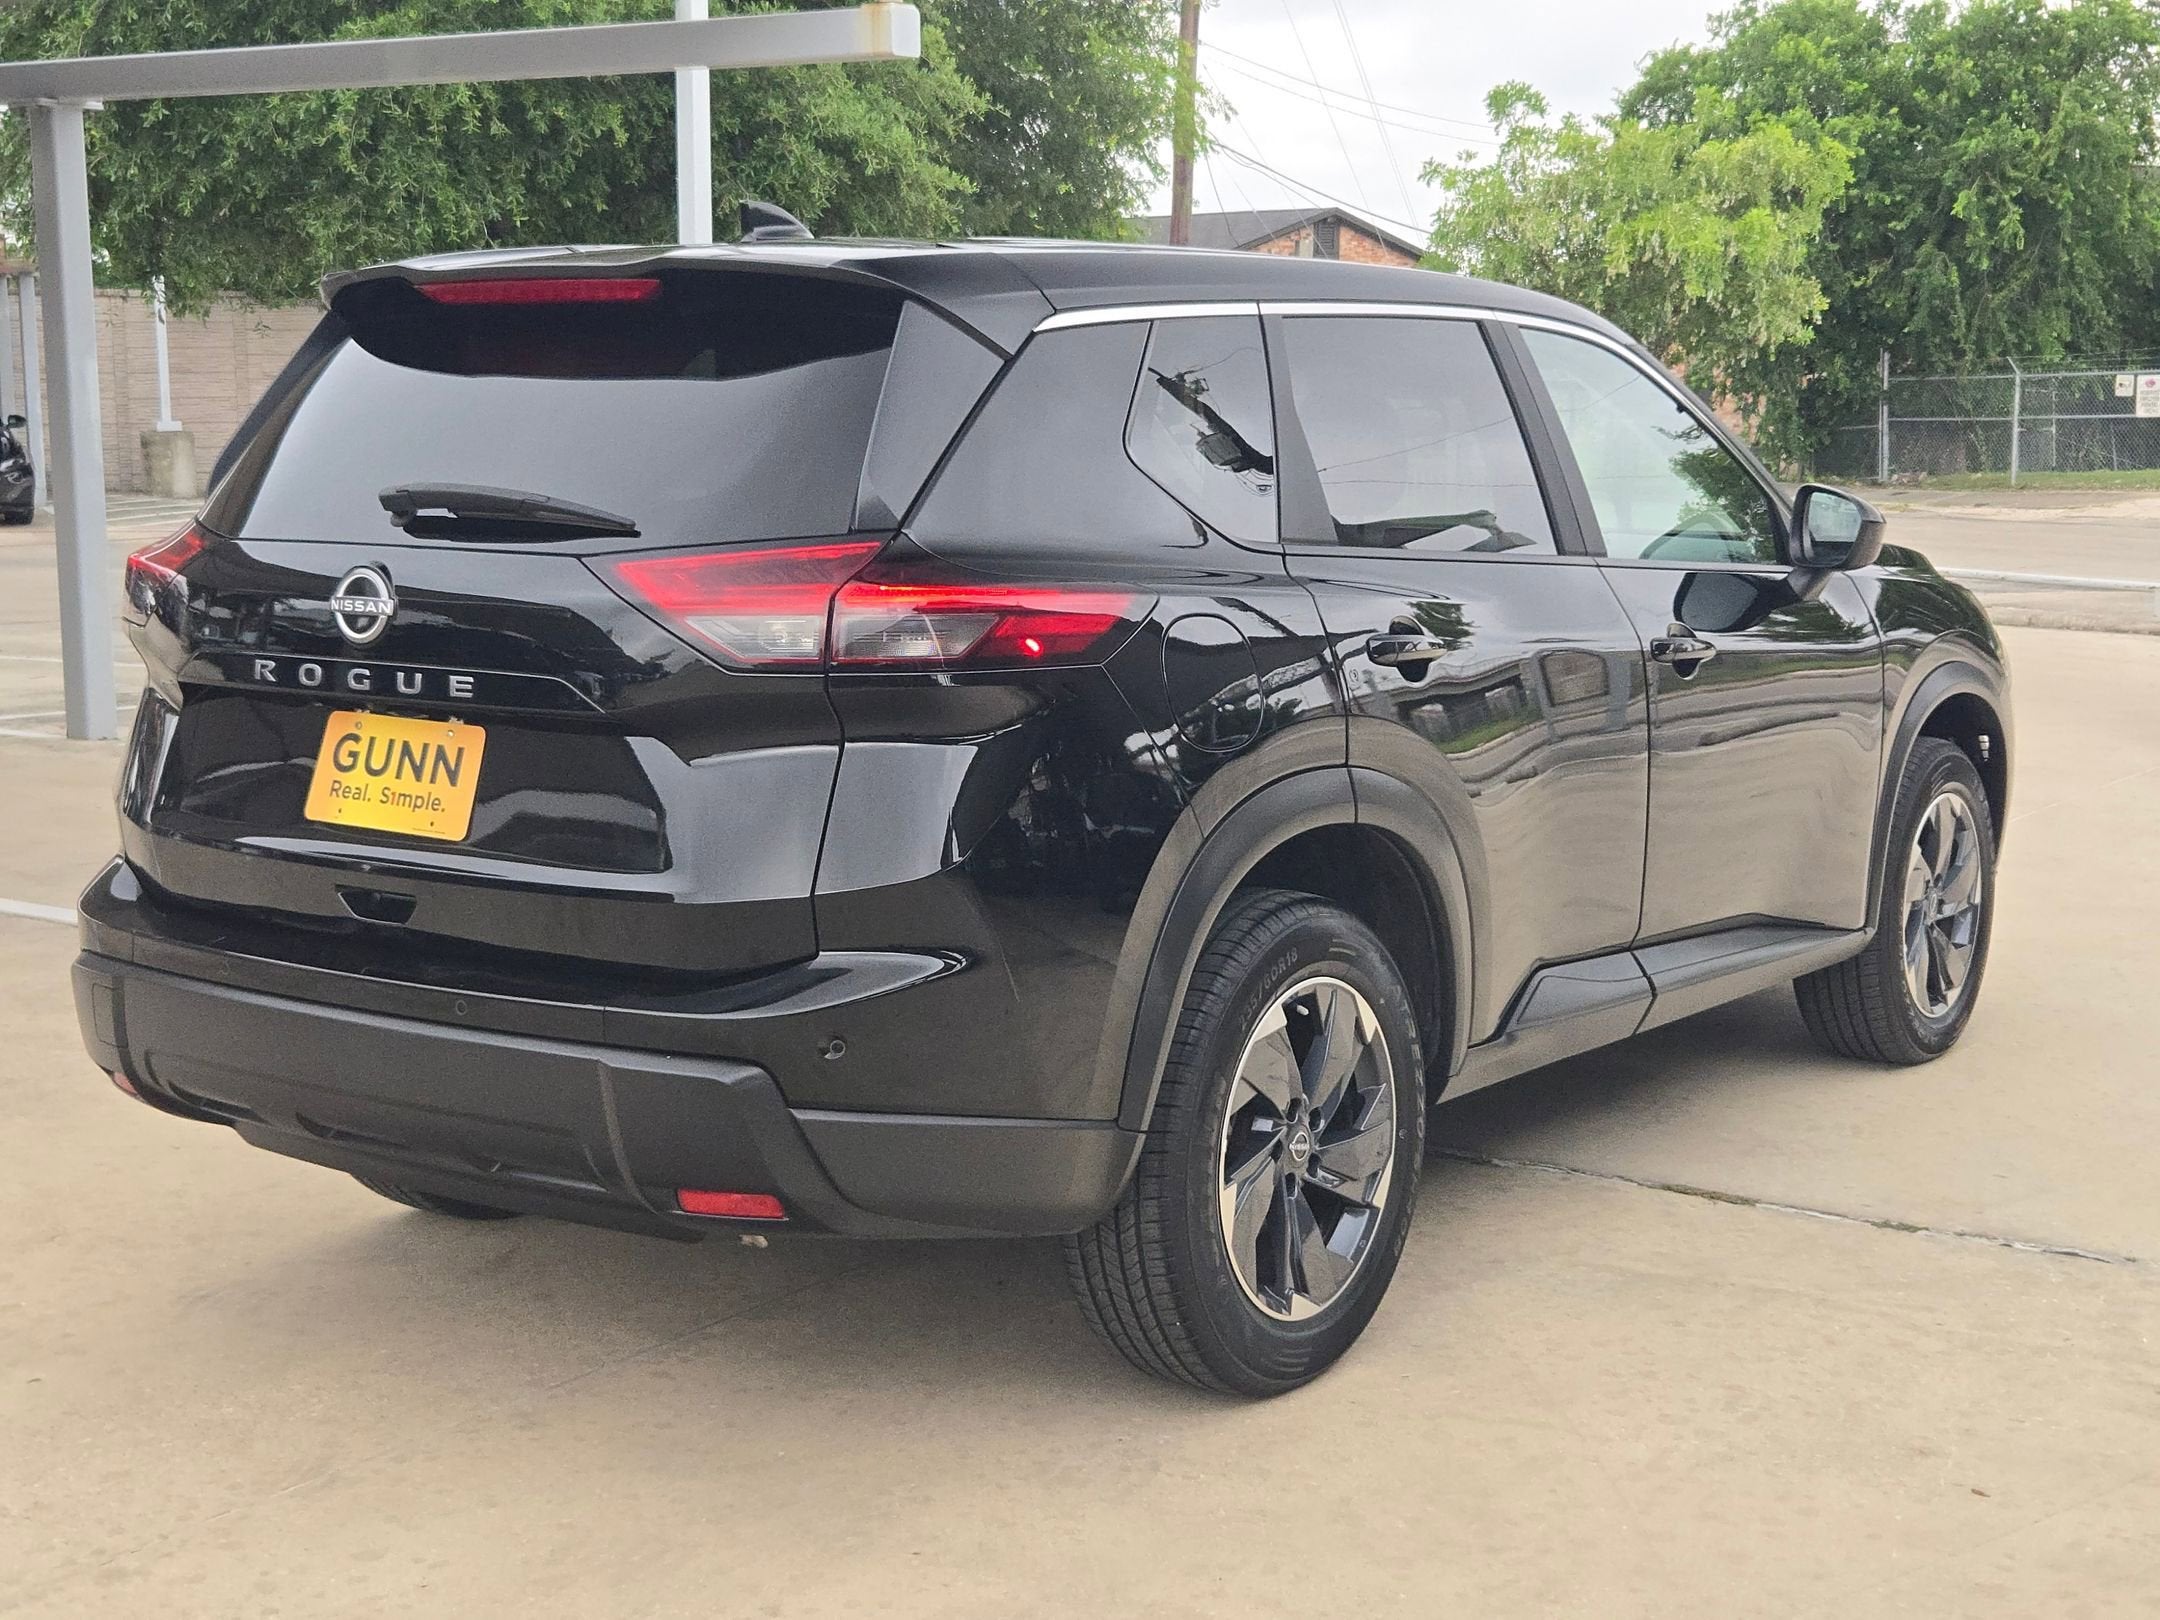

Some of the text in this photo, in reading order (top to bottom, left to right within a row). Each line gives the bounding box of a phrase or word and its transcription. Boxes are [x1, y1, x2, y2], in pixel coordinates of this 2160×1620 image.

[331, 598, 393, 615] NISSAN
[254, 659, 475, 698] ROGUE
[332, 732, 465, 788] GUNN
[329, 780, 371, 802] Real.
